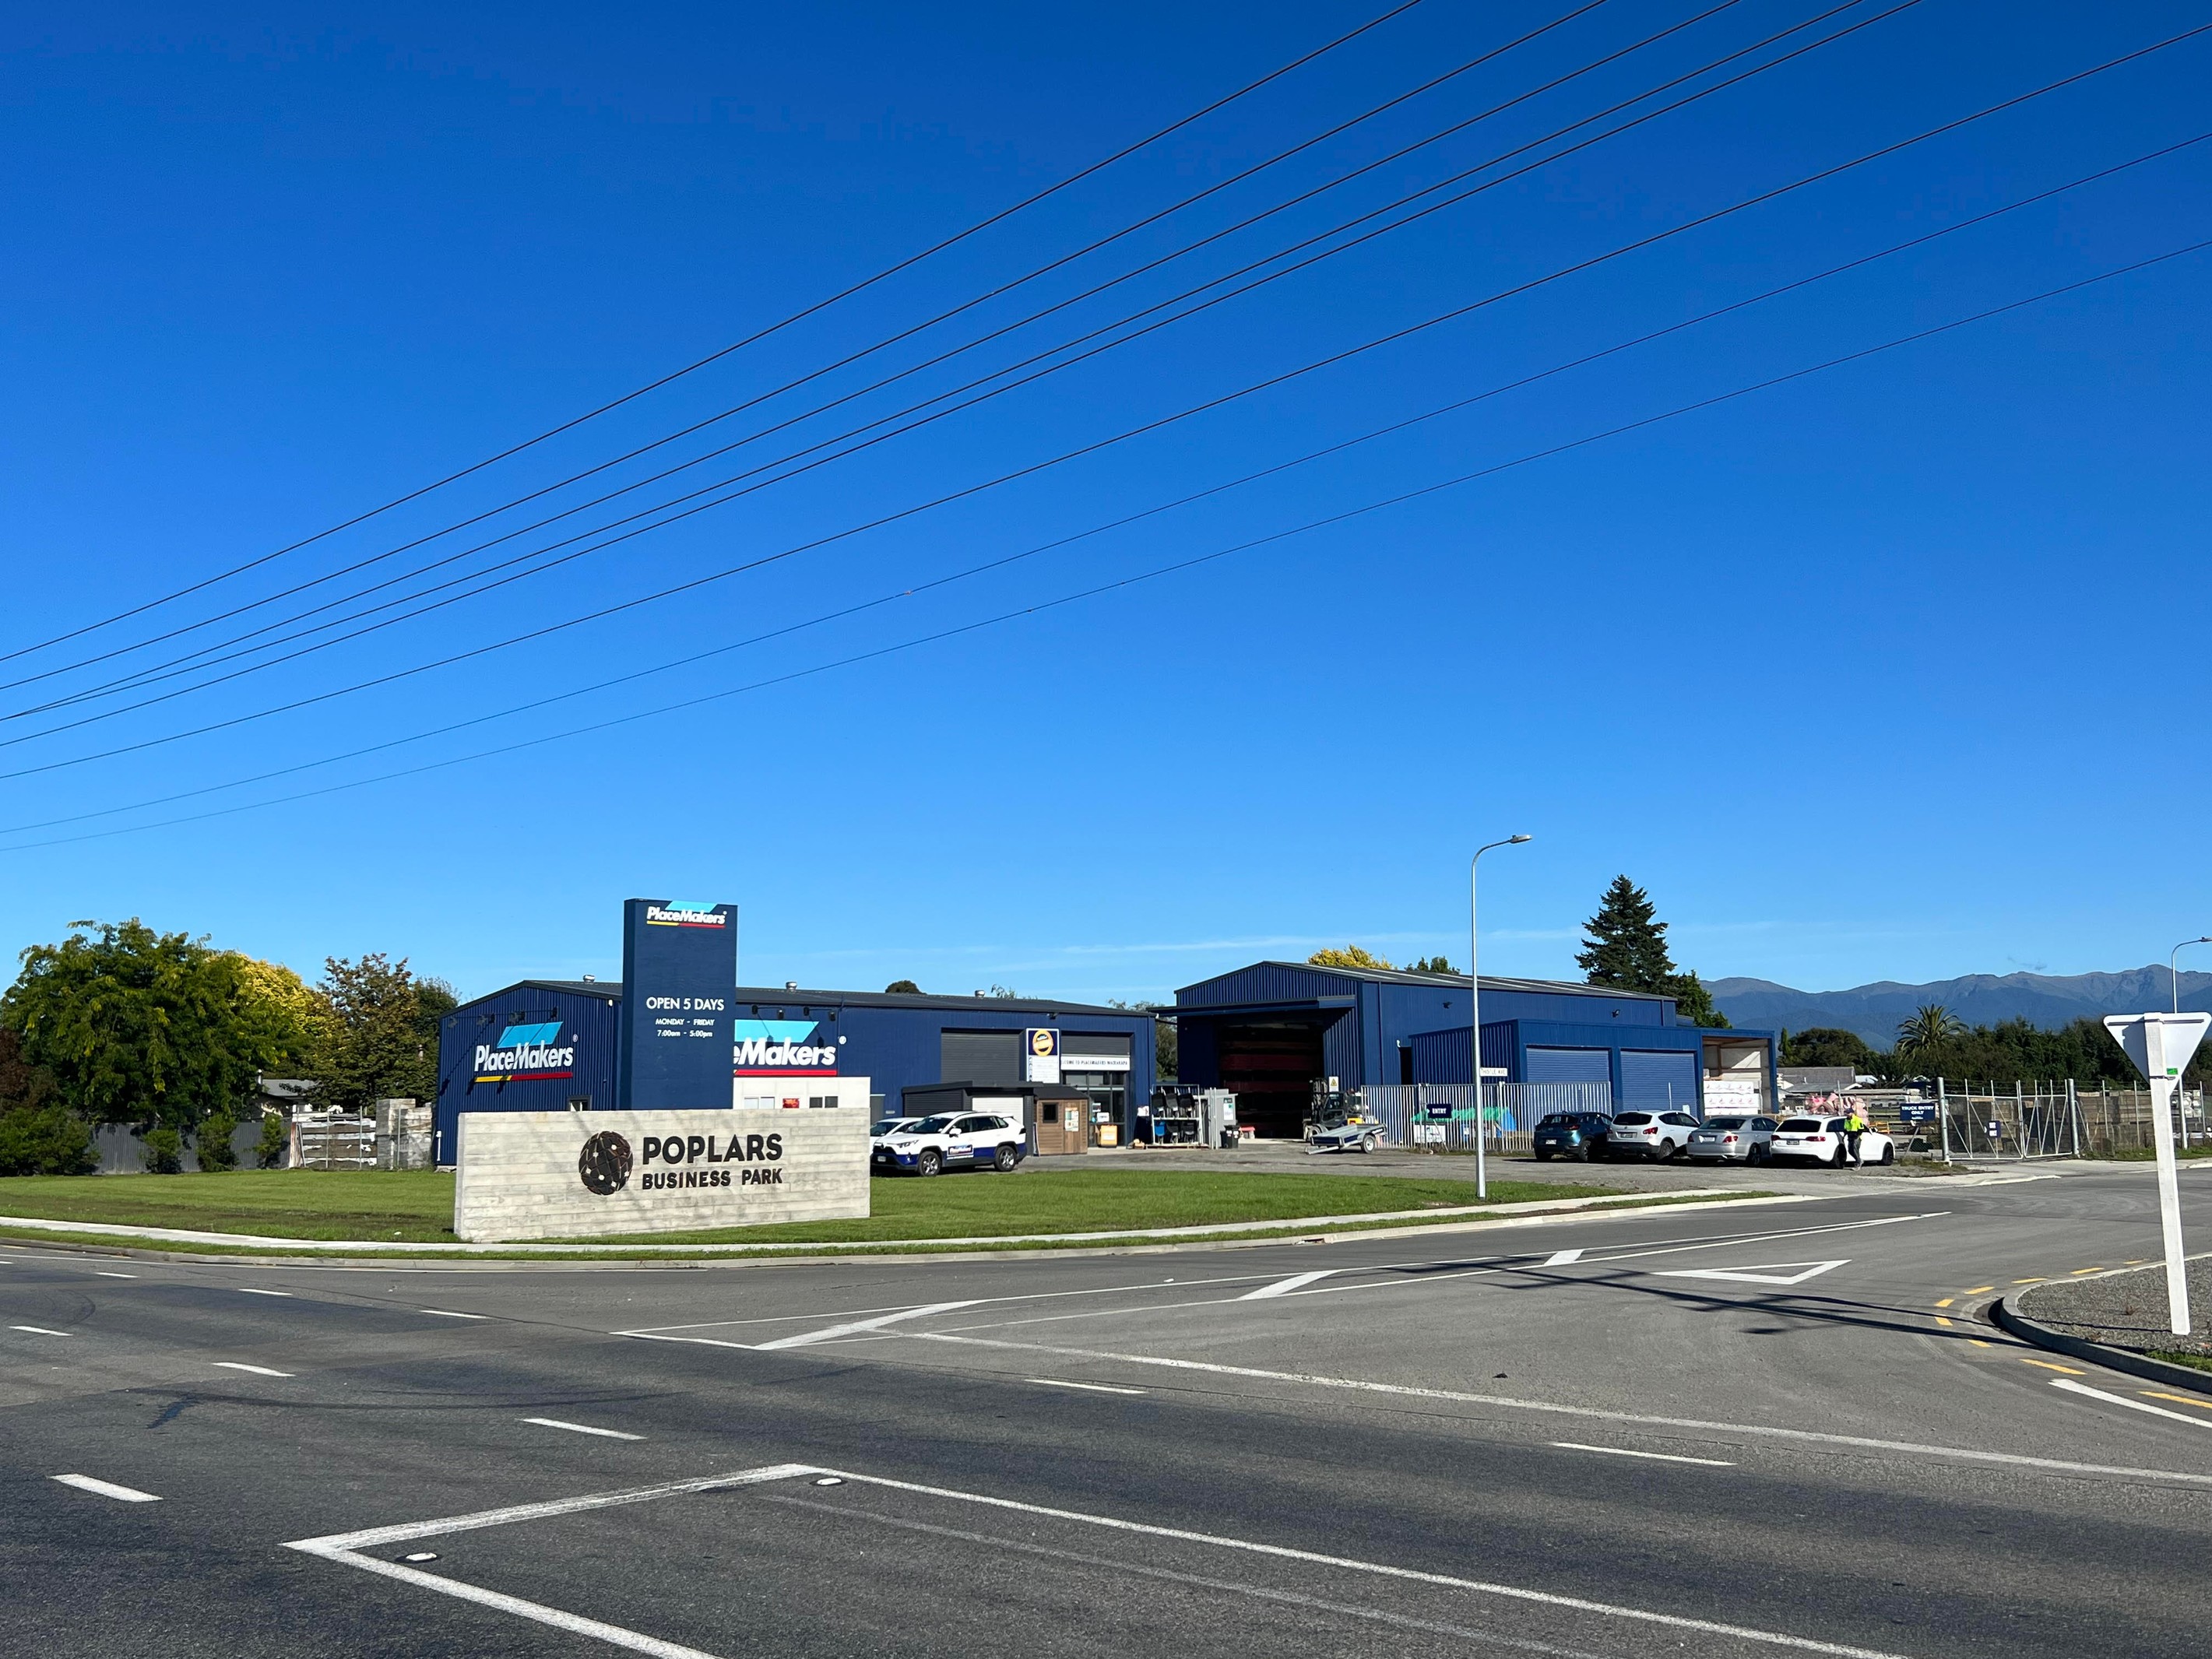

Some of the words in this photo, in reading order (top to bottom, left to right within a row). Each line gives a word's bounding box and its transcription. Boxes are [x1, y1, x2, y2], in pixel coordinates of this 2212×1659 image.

[646, 906, 725, 924] PlaceMakers
[646, 996, 680, 1010] OPEN
[683, 998, 691, 1010] 5
[695, 999, 724, 1011] DAYS
[474, 1040, 574, 1071] PlaceMakers
[733, 1037, 836, 1066] eMakers
[642, 1134, 782, 1165] POPLARS
[642, 1170, 731, 1190] BUSINESS
[741, 1169, 782, 1185] PARK
